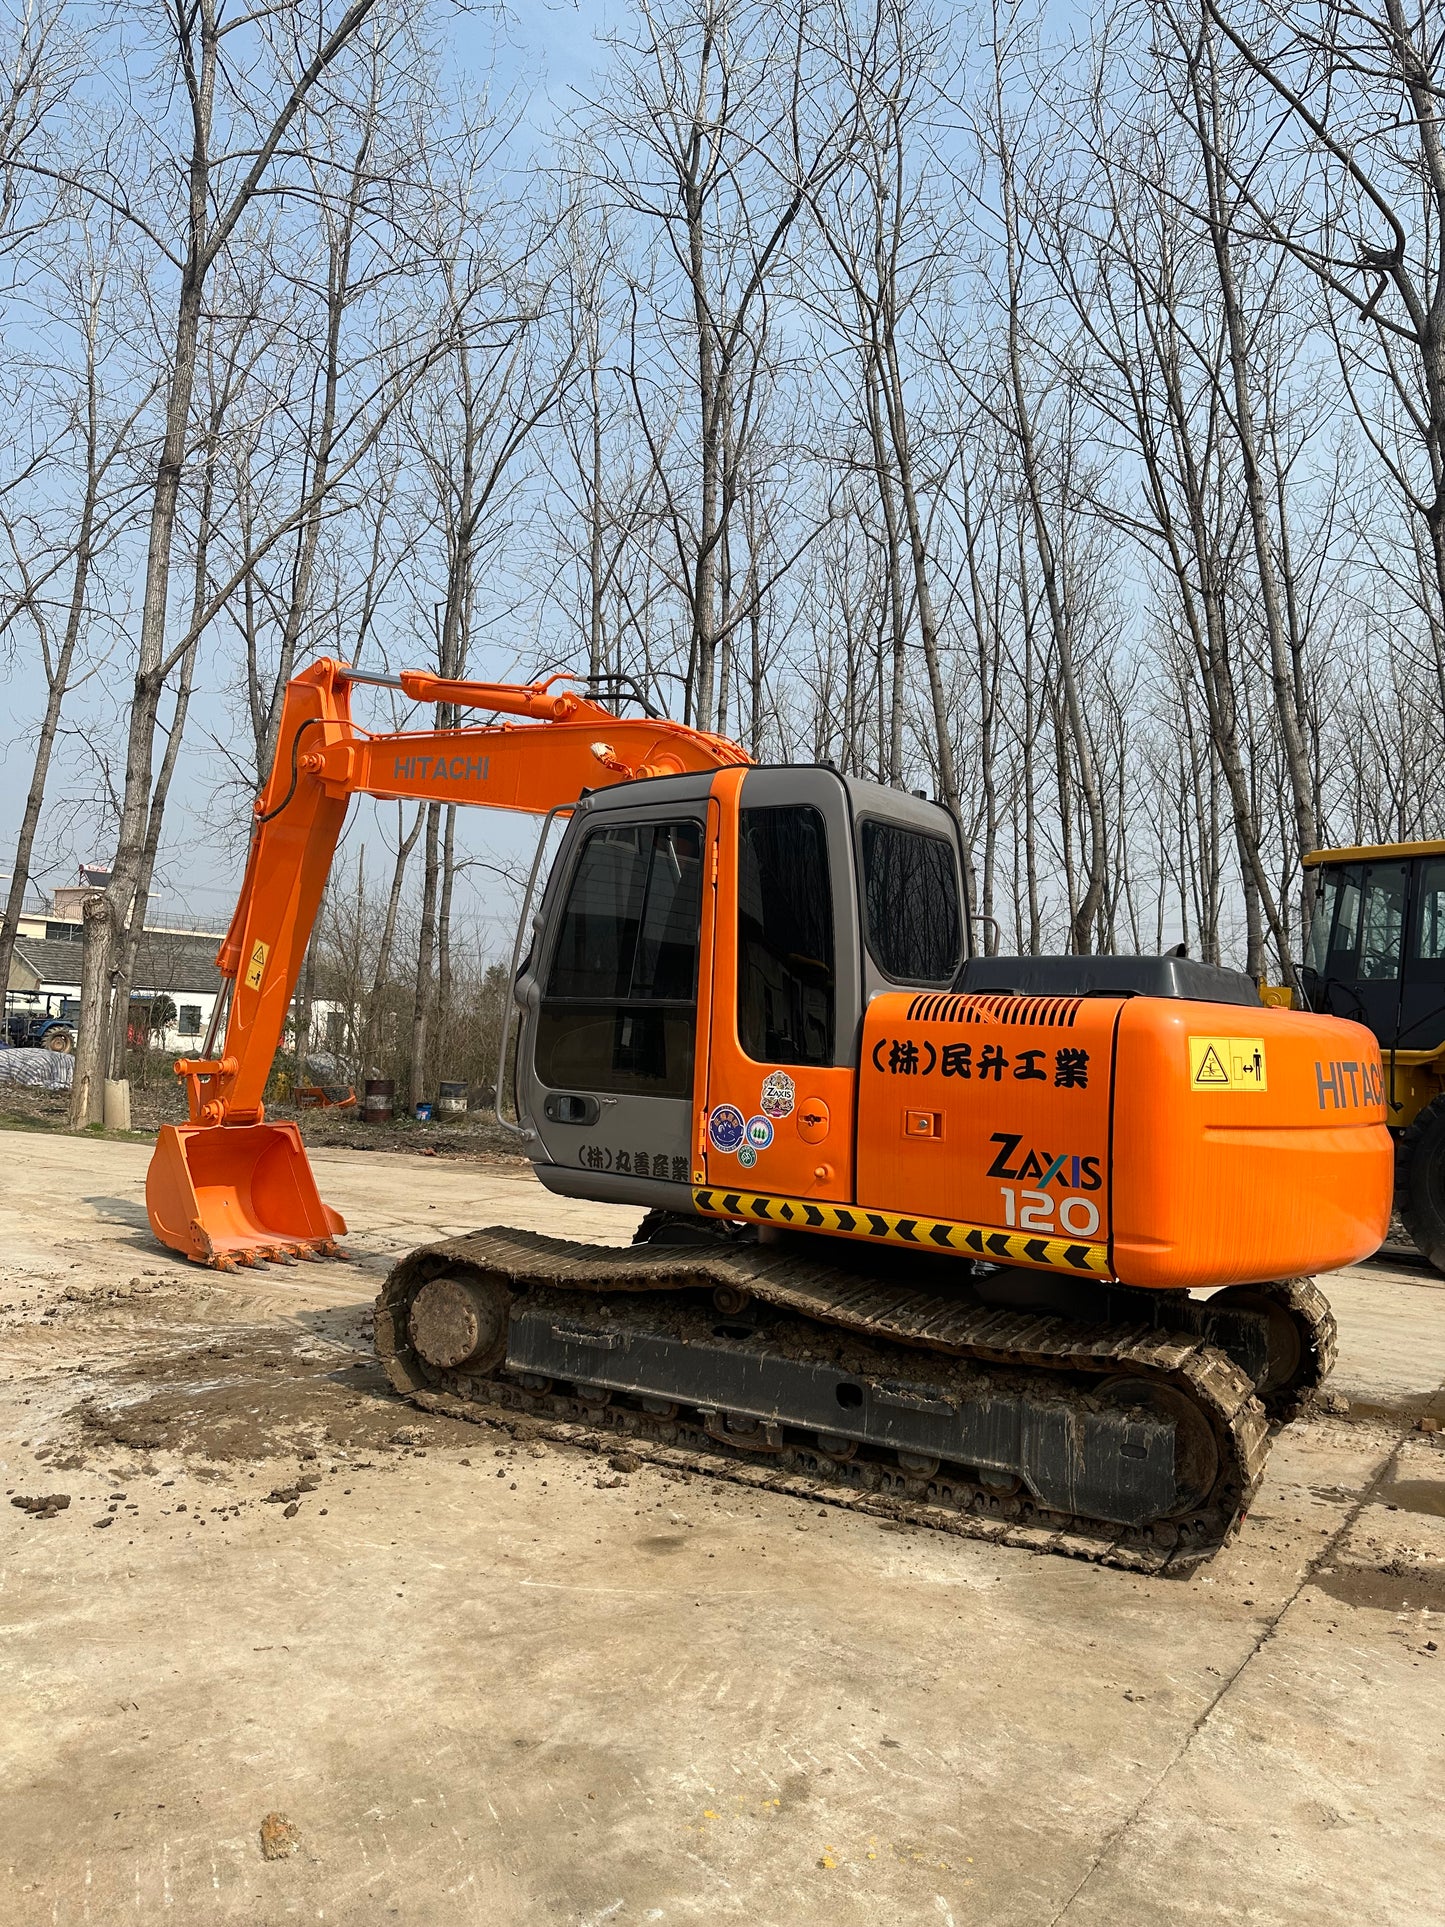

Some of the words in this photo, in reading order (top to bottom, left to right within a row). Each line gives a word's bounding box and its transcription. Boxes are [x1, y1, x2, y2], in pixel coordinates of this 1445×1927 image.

[394, 756, 490, 780] HITACHI
[986, 1132, 1102, 1191] ZAXIS
[1000, 1187, 1101, 1237] 120
